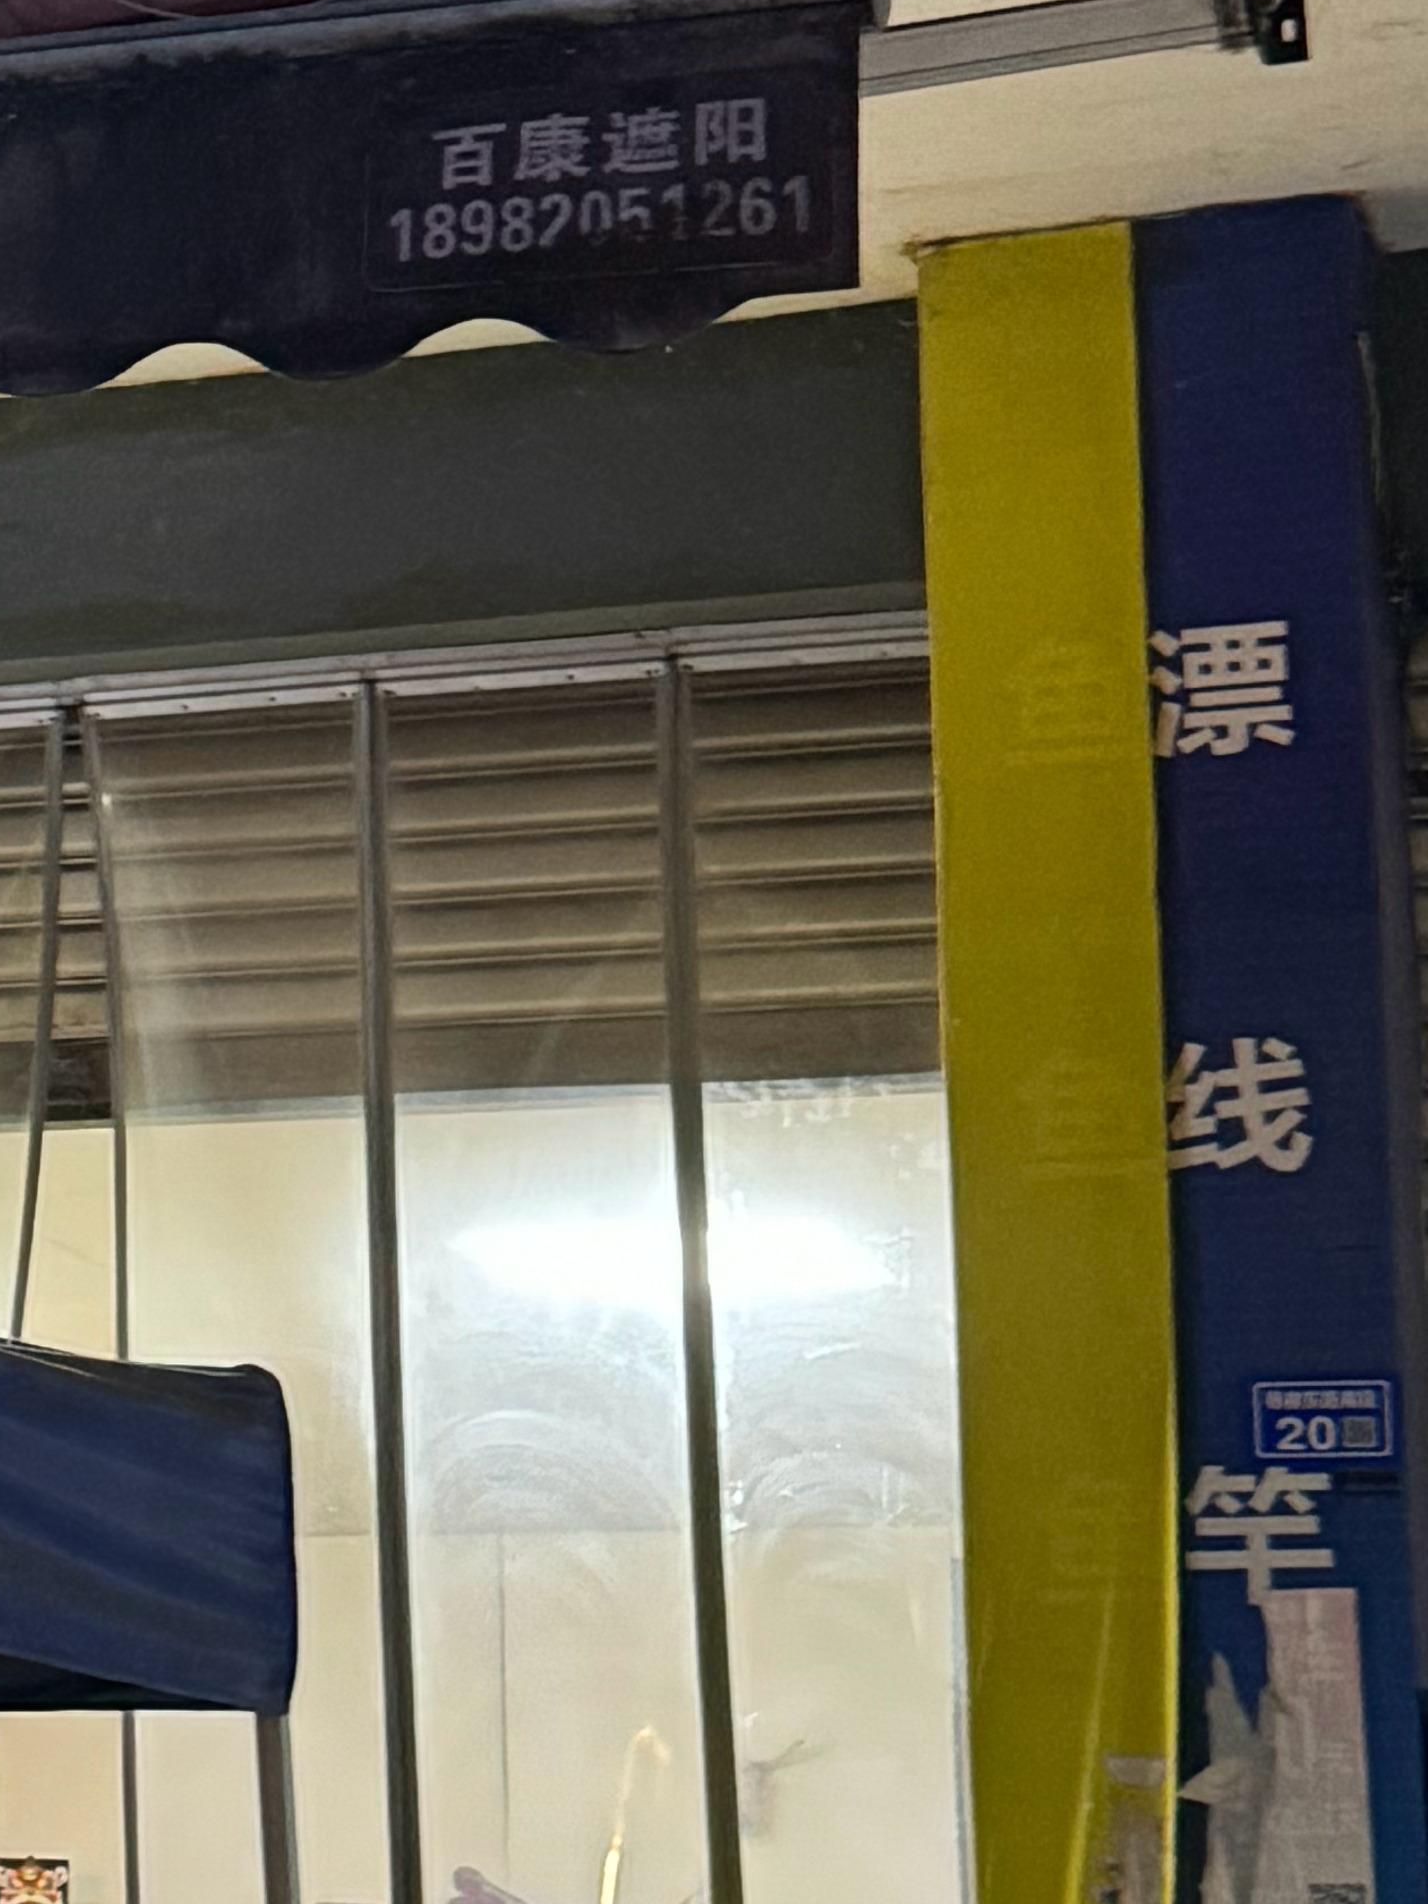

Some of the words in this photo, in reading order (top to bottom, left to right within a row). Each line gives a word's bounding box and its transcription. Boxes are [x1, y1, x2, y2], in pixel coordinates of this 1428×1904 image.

[431, 97, 769, 191] 百康遮阳
[1275, 1414, 1337, 1451] 20
